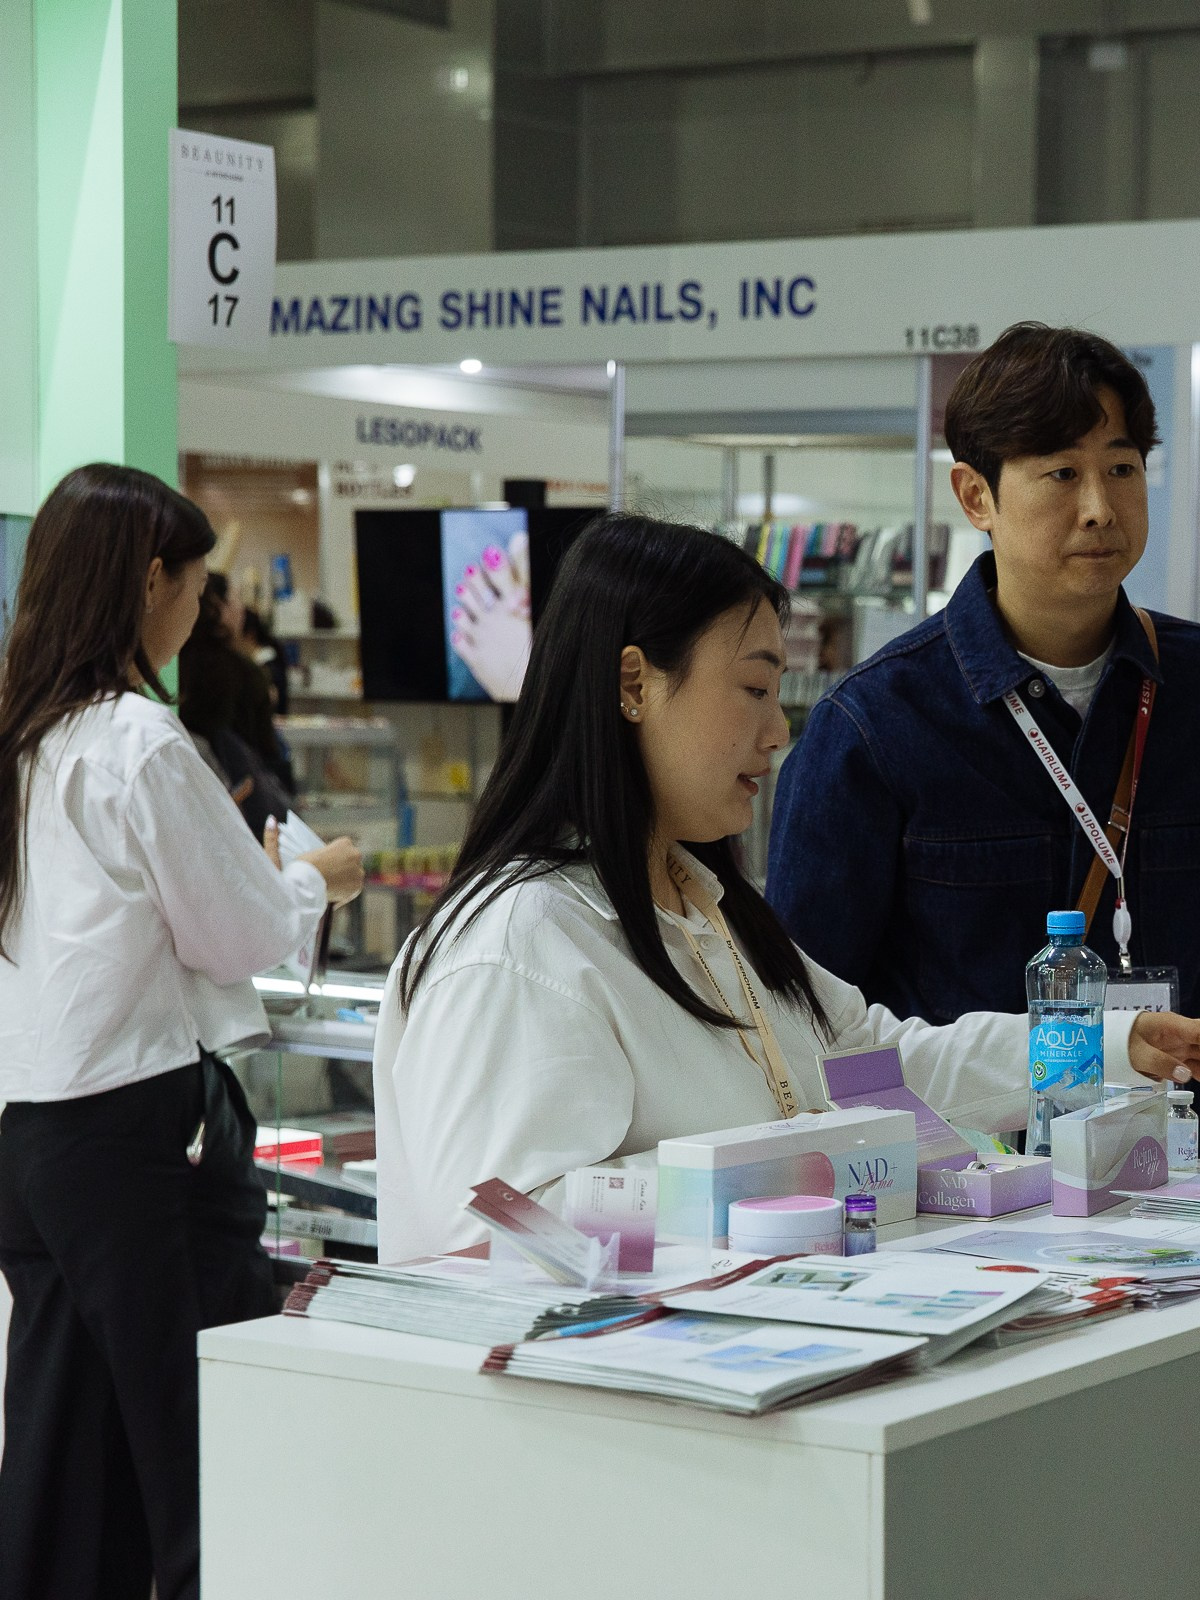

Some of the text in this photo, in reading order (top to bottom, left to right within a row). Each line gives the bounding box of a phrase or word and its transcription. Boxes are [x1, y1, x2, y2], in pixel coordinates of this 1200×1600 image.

[211, 193, 237, 225] 11
[208, 233, 240, 285] C
[208, 293, 240, 327] 17
[271, 273, 818, 336] MAZING SHINE NAILS, INC
[355, 413, 483, 454] LESOPACK
[1033, 737, 1072, 792] HAIRLUMA
[1081, 813, 1116, 866] LIPOLUME
[732, 951, 760, 1011] INTERCHARM
[1035, 1027, 1089, 1051] AQUA
[1040, 1050, 1083, 1058] MINERALE
[848, 1157, 898, 1188] NAD+
[918, 1191, 976, 1212] Collagen
